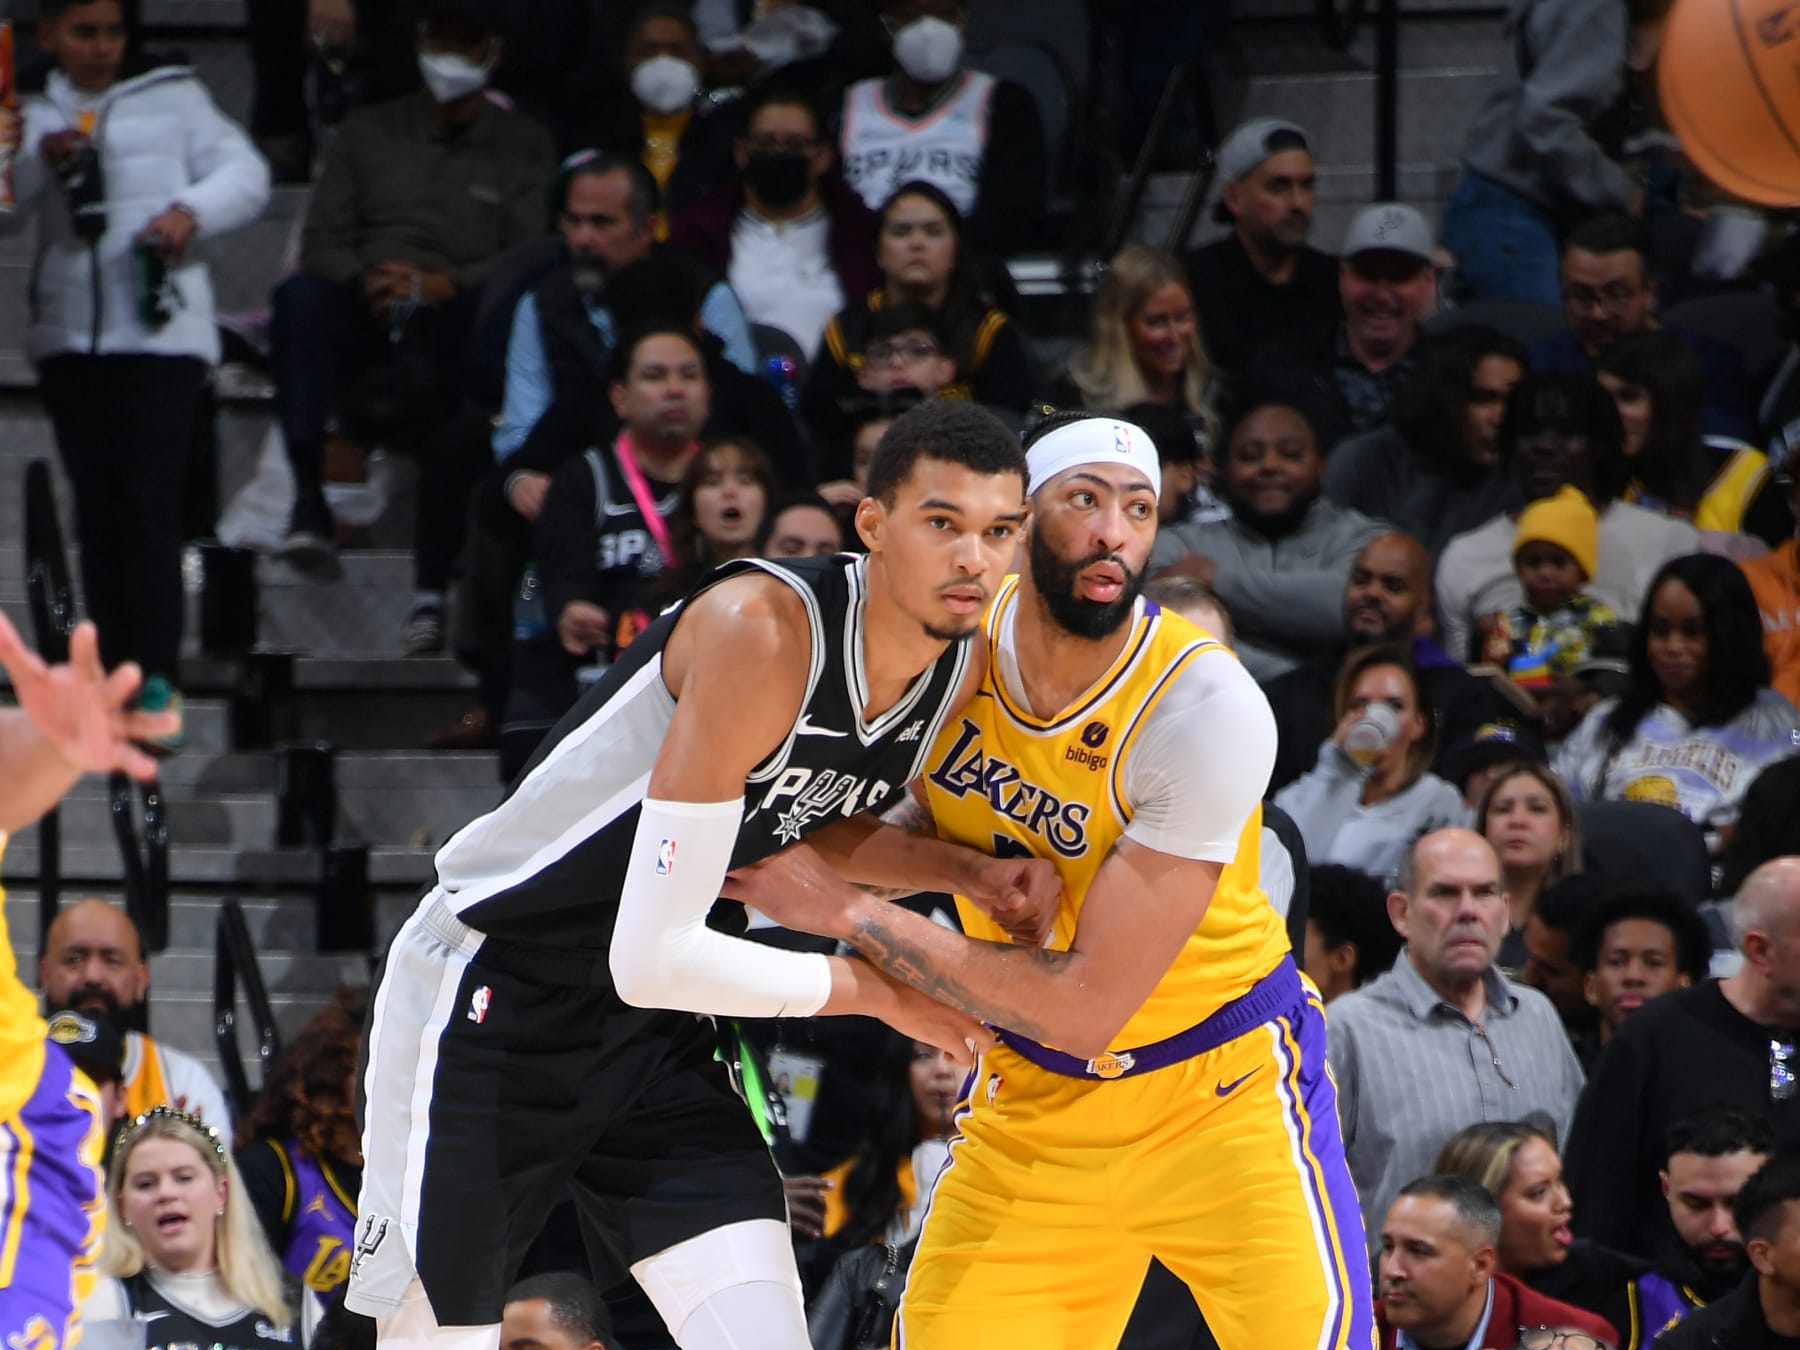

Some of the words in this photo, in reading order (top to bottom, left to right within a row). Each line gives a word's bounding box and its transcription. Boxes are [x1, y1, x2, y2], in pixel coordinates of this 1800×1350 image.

[894, 720, 925, 743] elf.
[1065, 746, 1108, 772] bibigo
[928, 717, 1092, 859] LAKERS
